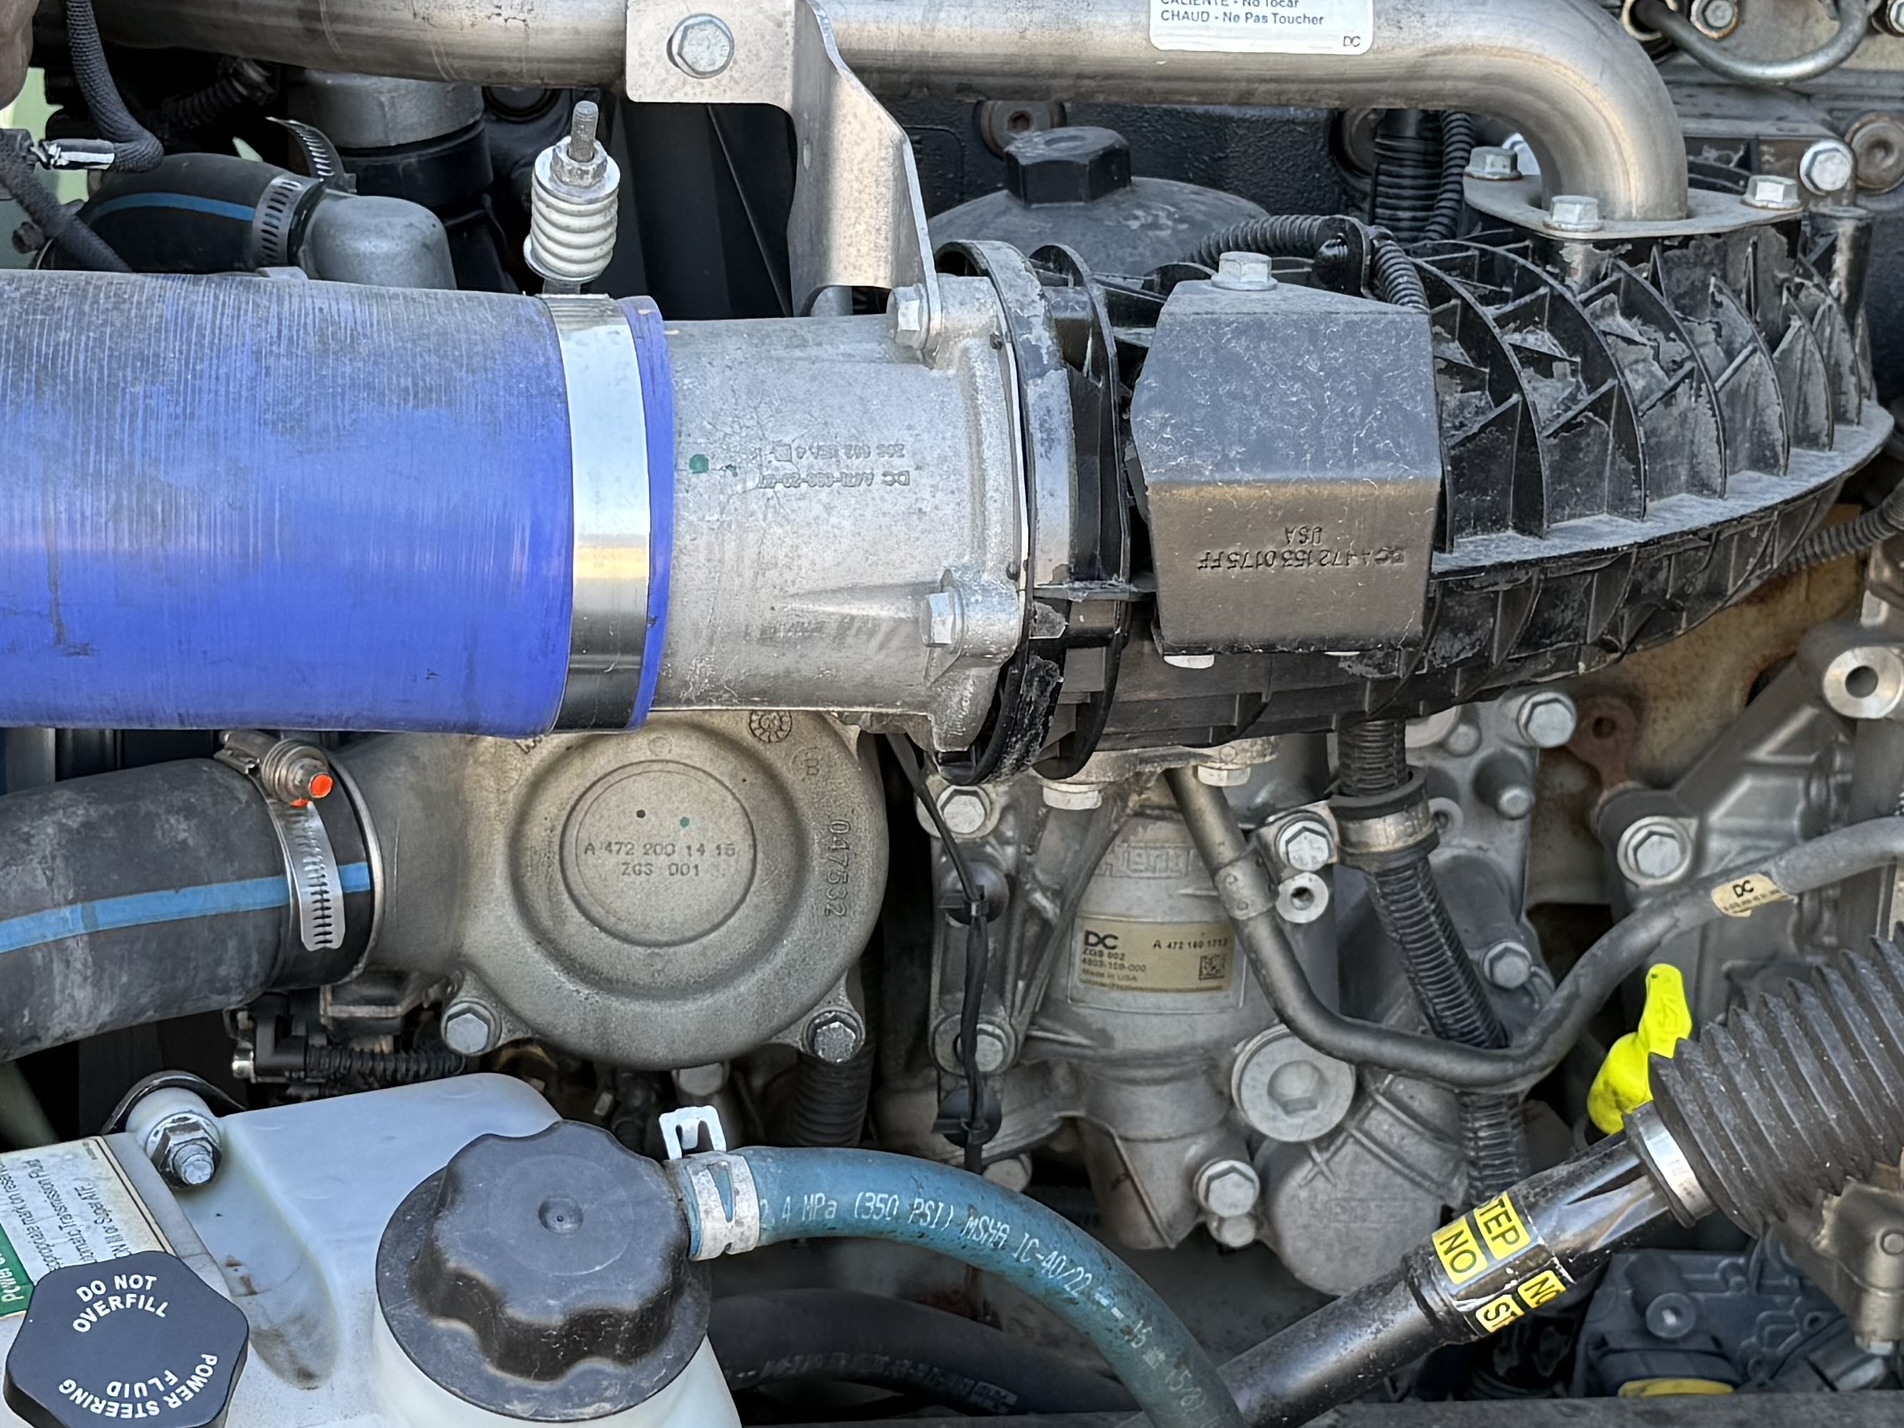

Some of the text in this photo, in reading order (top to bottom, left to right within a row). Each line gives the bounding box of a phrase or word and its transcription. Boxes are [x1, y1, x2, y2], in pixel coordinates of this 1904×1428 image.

[1159, 9, 1211, 23] CHAUD
[1244, 12, 1269, 25] Pas
[1271, 12, 1325, 26] Toucher
[1342, 34, 1362, 48] DC
[1284, 526, 1323, 546] USA
[604, 842, 636, 856] 472
[685, 843, 706, 857] 14
[621, 863, 654, 877] ZGS
[822, 818, 852, 918] 047532
[1731, 879, 1755, 899] DC
[1083, 930, 1119, 951] DC
[1153, 939, 1162, 950] A
[801, 1193, 838, 1222] MPa
[853, 1190, 899, 1221] (350
[907, 1197, 955, 1233] PSI)
[961, 1215, 1011, 1251] MSHA
[1012, 1232, 1095, 1296] IC-40/22
[1438, 1228, 1478, 1275] NO
[76, 1273, 158, 1303] DO NOT
[72, 1293, 170, 1333] OVERFILL
[58, 1352, 218, 1419] POWER STEERING
[106, 1369, 180, 1399] FLUID
